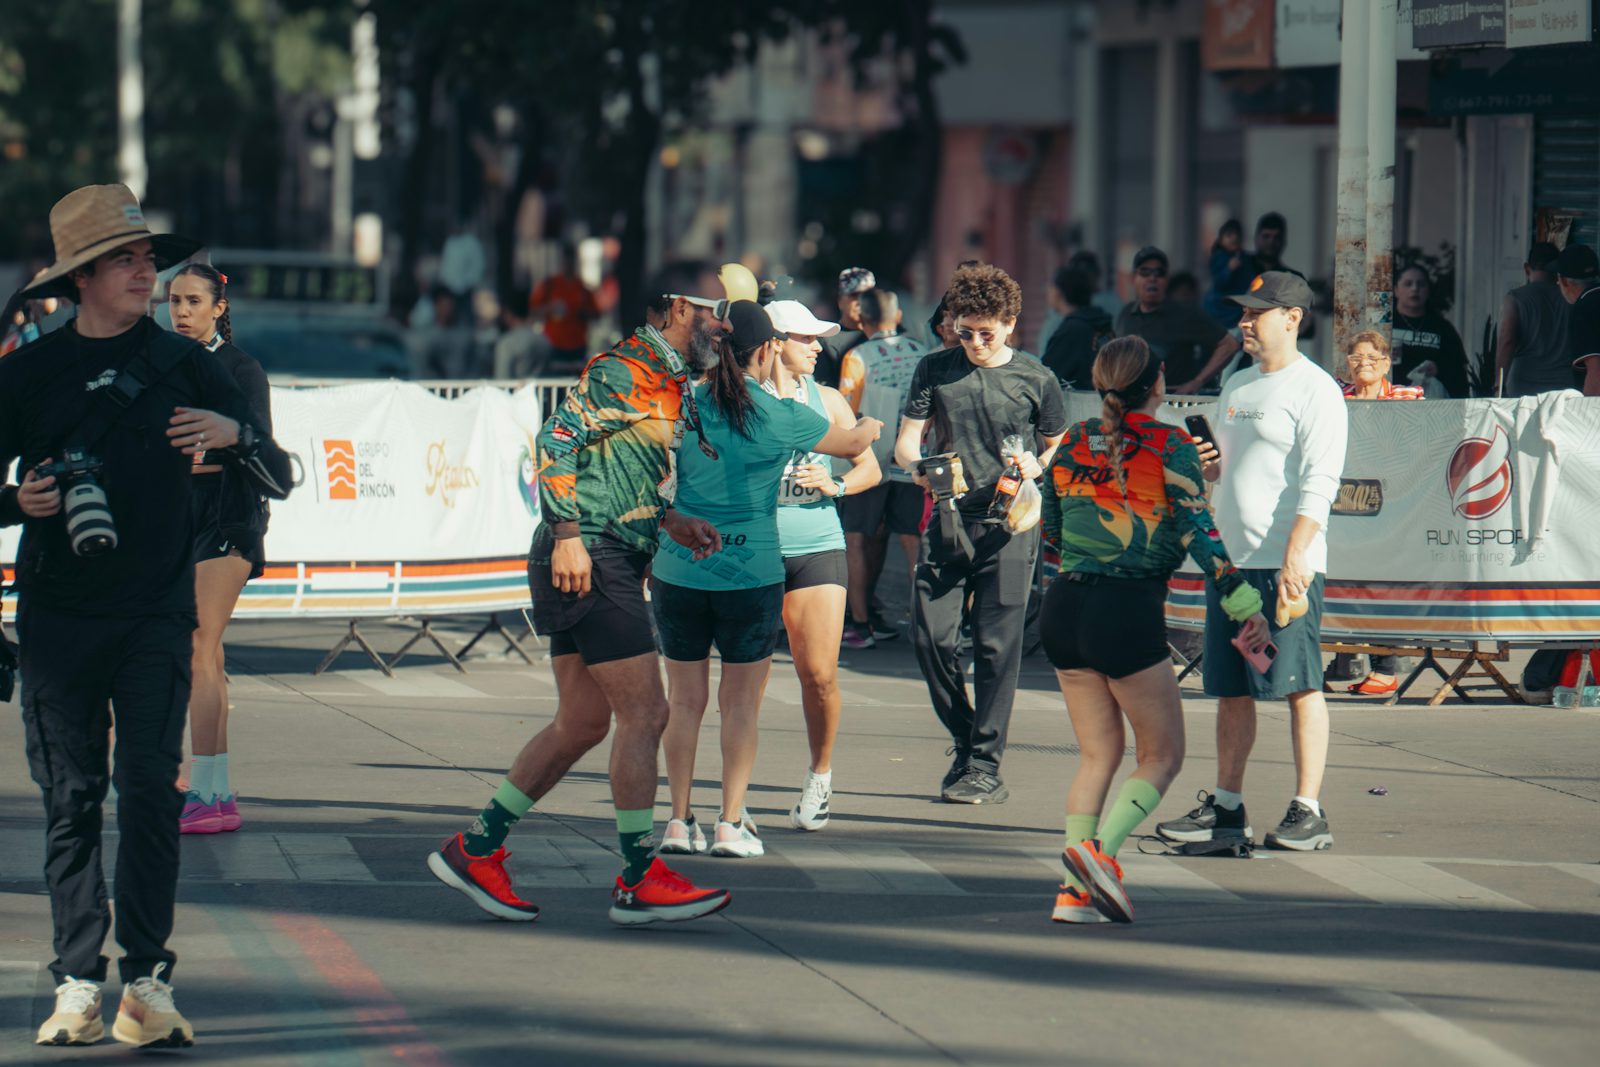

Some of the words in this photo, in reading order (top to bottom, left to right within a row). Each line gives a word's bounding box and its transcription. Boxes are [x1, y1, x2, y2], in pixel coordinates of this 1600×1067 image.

[358, 442, 389, 457] GRUPO
[359, 463, 374, 477] DEL
[1426, 529, 1460, 546] RUN
[1466, 529, 1550, 546] SPOR
